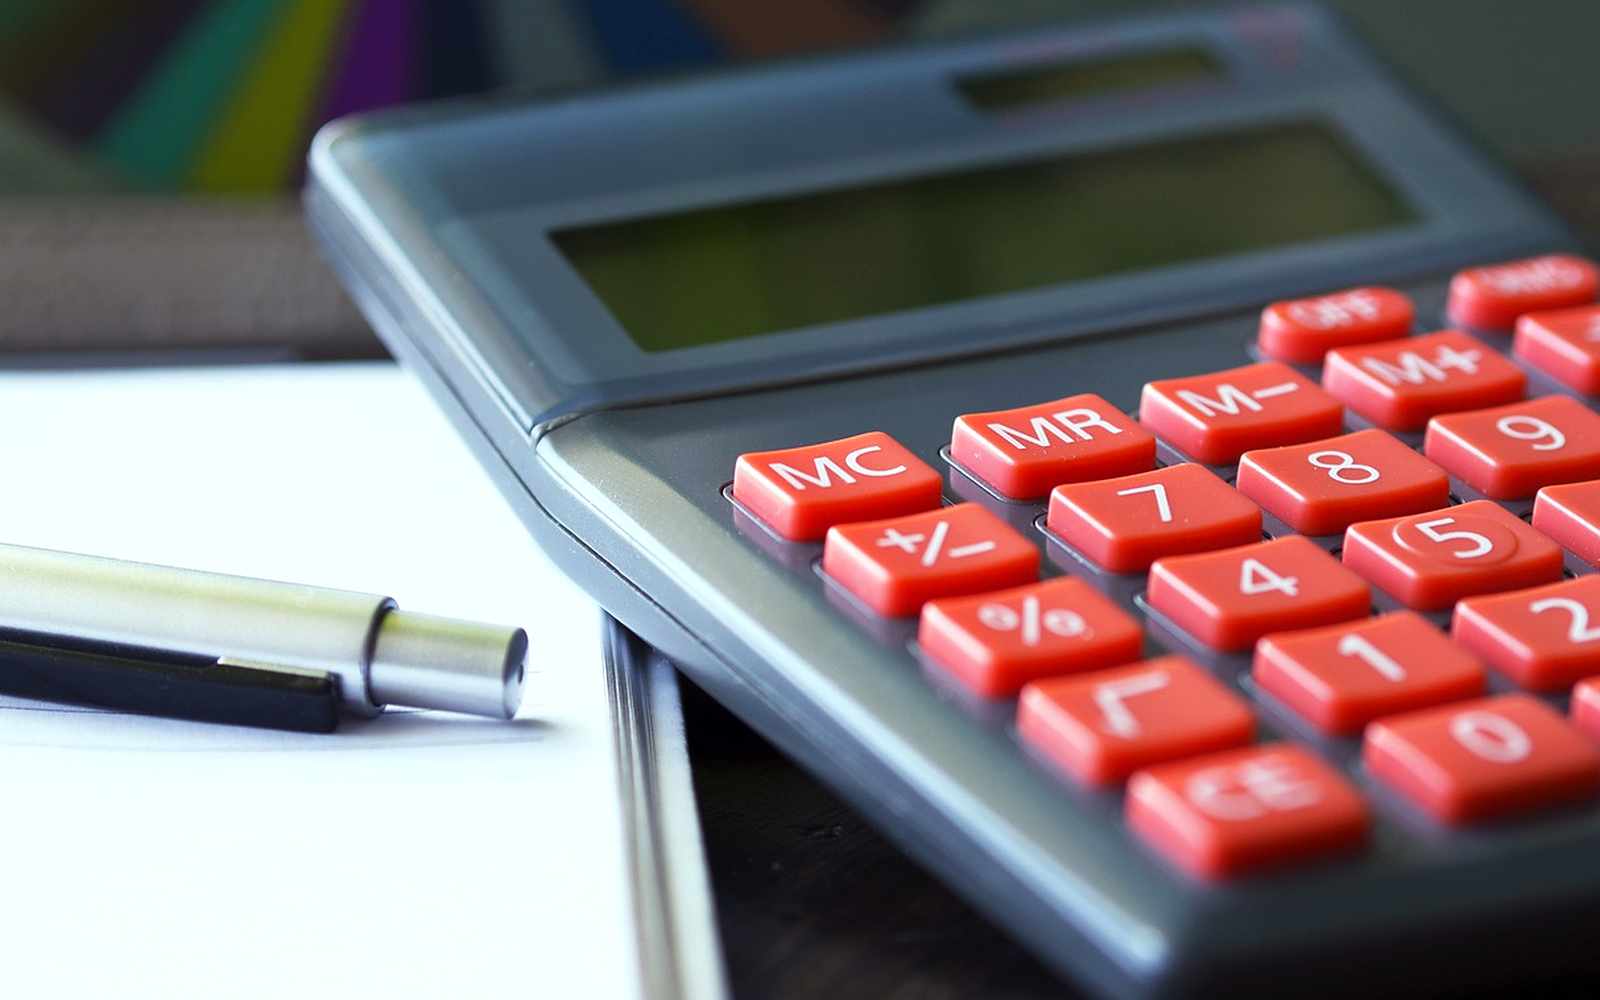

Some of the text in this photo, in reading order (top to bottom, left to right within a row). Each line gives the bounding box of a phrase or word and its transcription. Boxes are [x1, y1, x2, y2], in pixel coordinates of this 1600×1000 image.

[1361, 345, 1481, 384] M+
[988, 408, 1122, 450] MR
[1496, 415, 1566, 450] 9
[768, 446, 906, 490] MC
[1307, 450, 1381, 484] 8
[1117, 483, 1174, 522] 7
[1414, 517, 1493, 559] 5
[1240, 558, 1299, 597] 4
[976, 597, 1086, 648] %
[1530, 598, 1600, 643] 2
[1338, 634, 1406, 683] 1
[1450, 710, 1532, 764] 0
